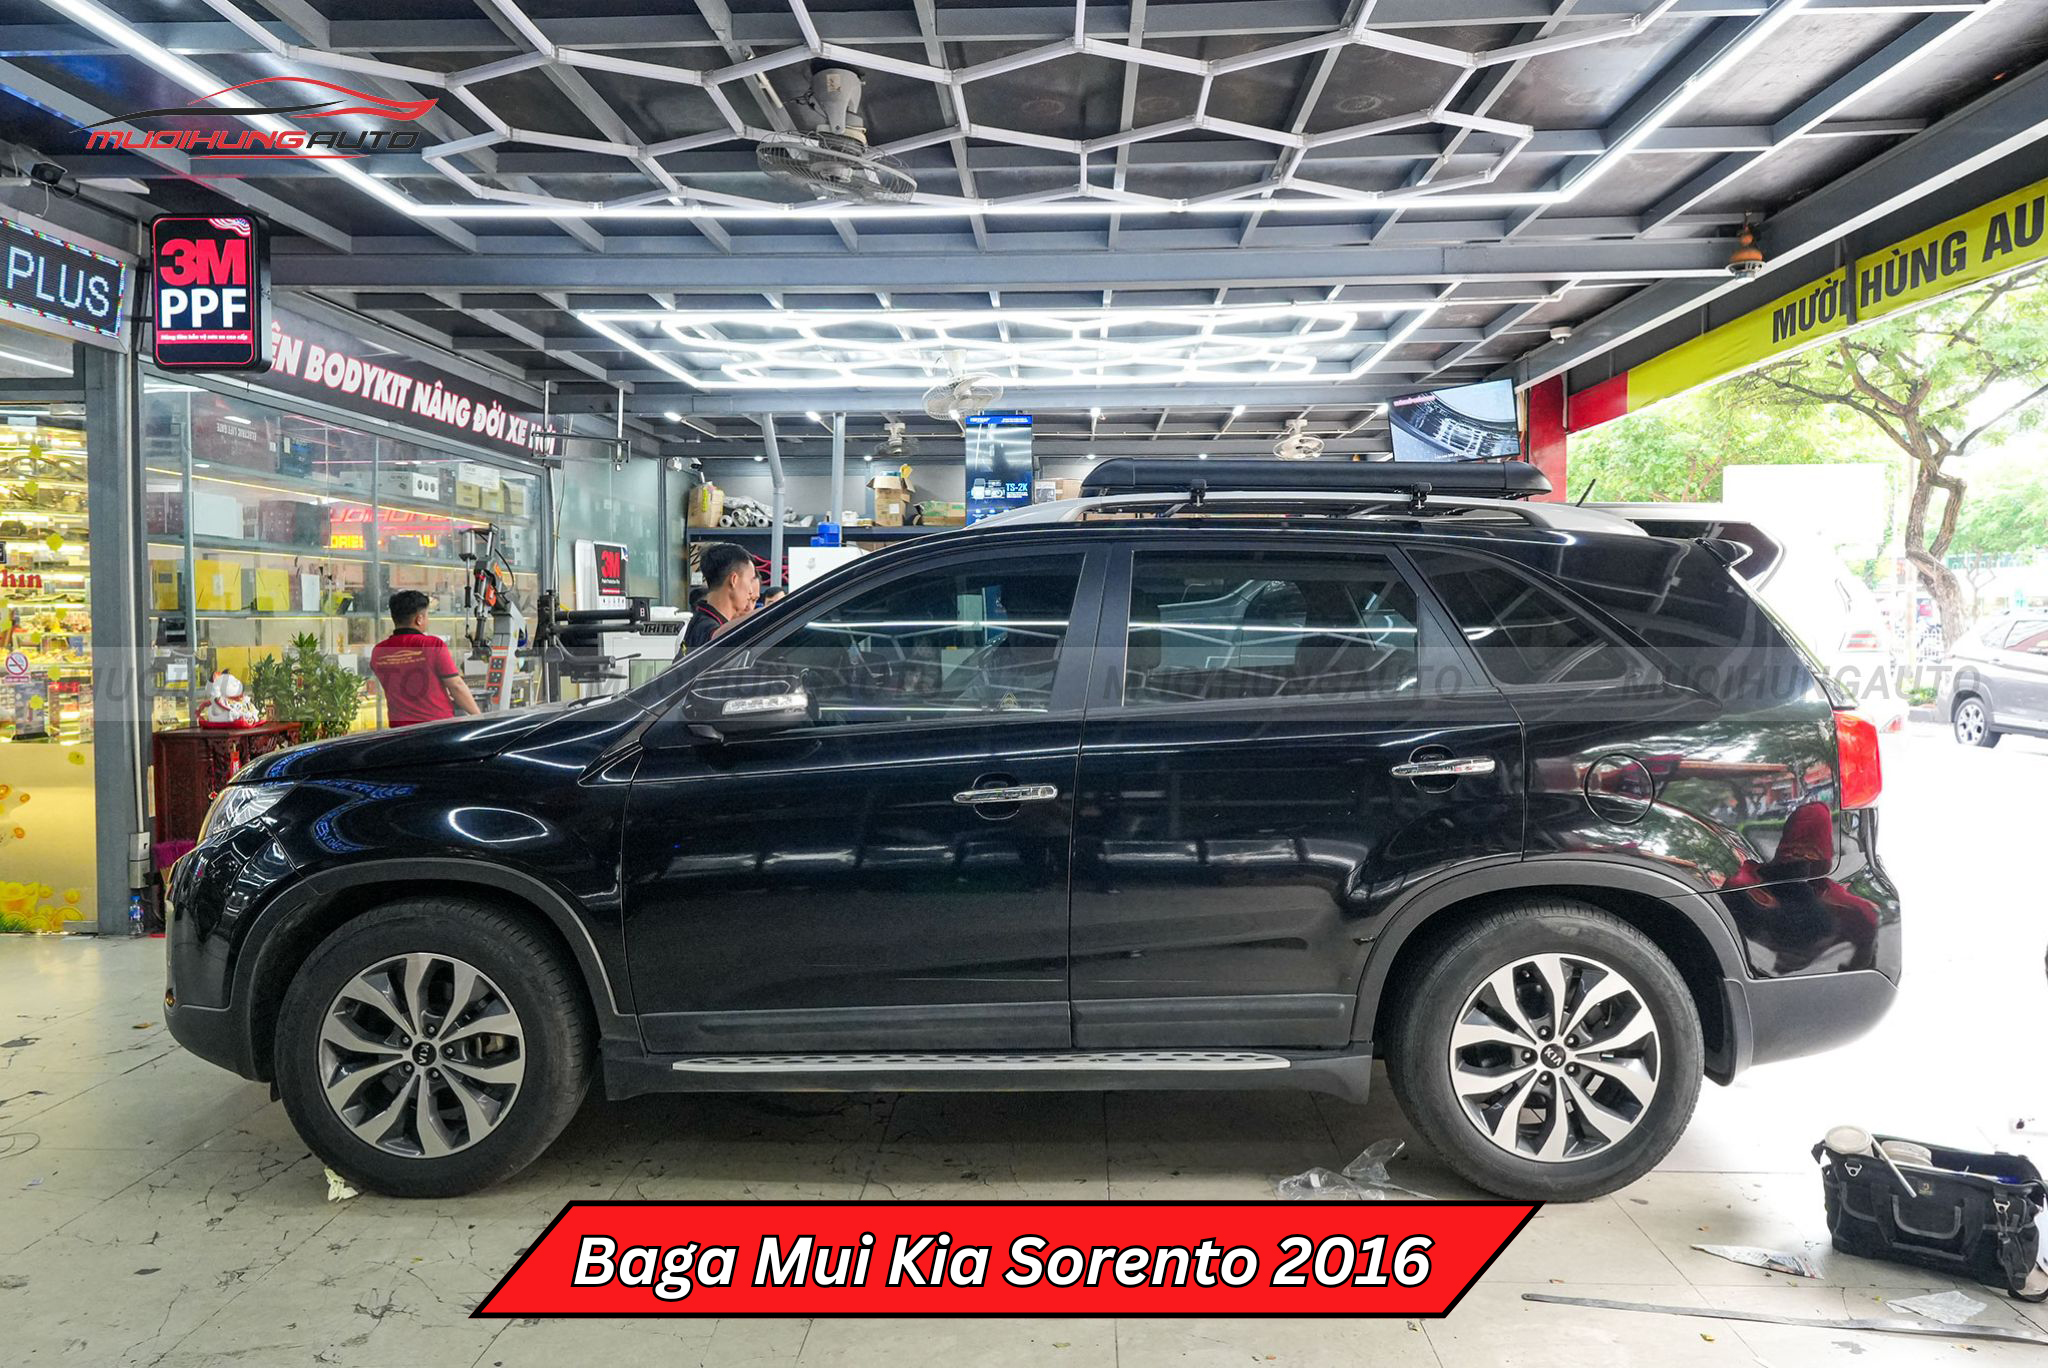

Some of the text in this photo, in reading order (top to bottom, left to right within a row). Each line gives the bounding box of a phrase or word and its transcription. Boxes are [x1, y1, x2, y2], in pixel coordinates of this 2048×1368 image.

[6, 245, 110, 317] PLUS
[160, 238, 247, 286] 3M
[1860, 229, 1968, 309] HÙNG
[160, 288, 247, 329] PPF
[304, 345, 412, 409] BODYKIT
[411, 379, 471, 429] NÂNG
[506, 414, 528, 448] XE
[601, 550, 621, 578] 3M
[1544, 1047, 1562, 1066] KIA
